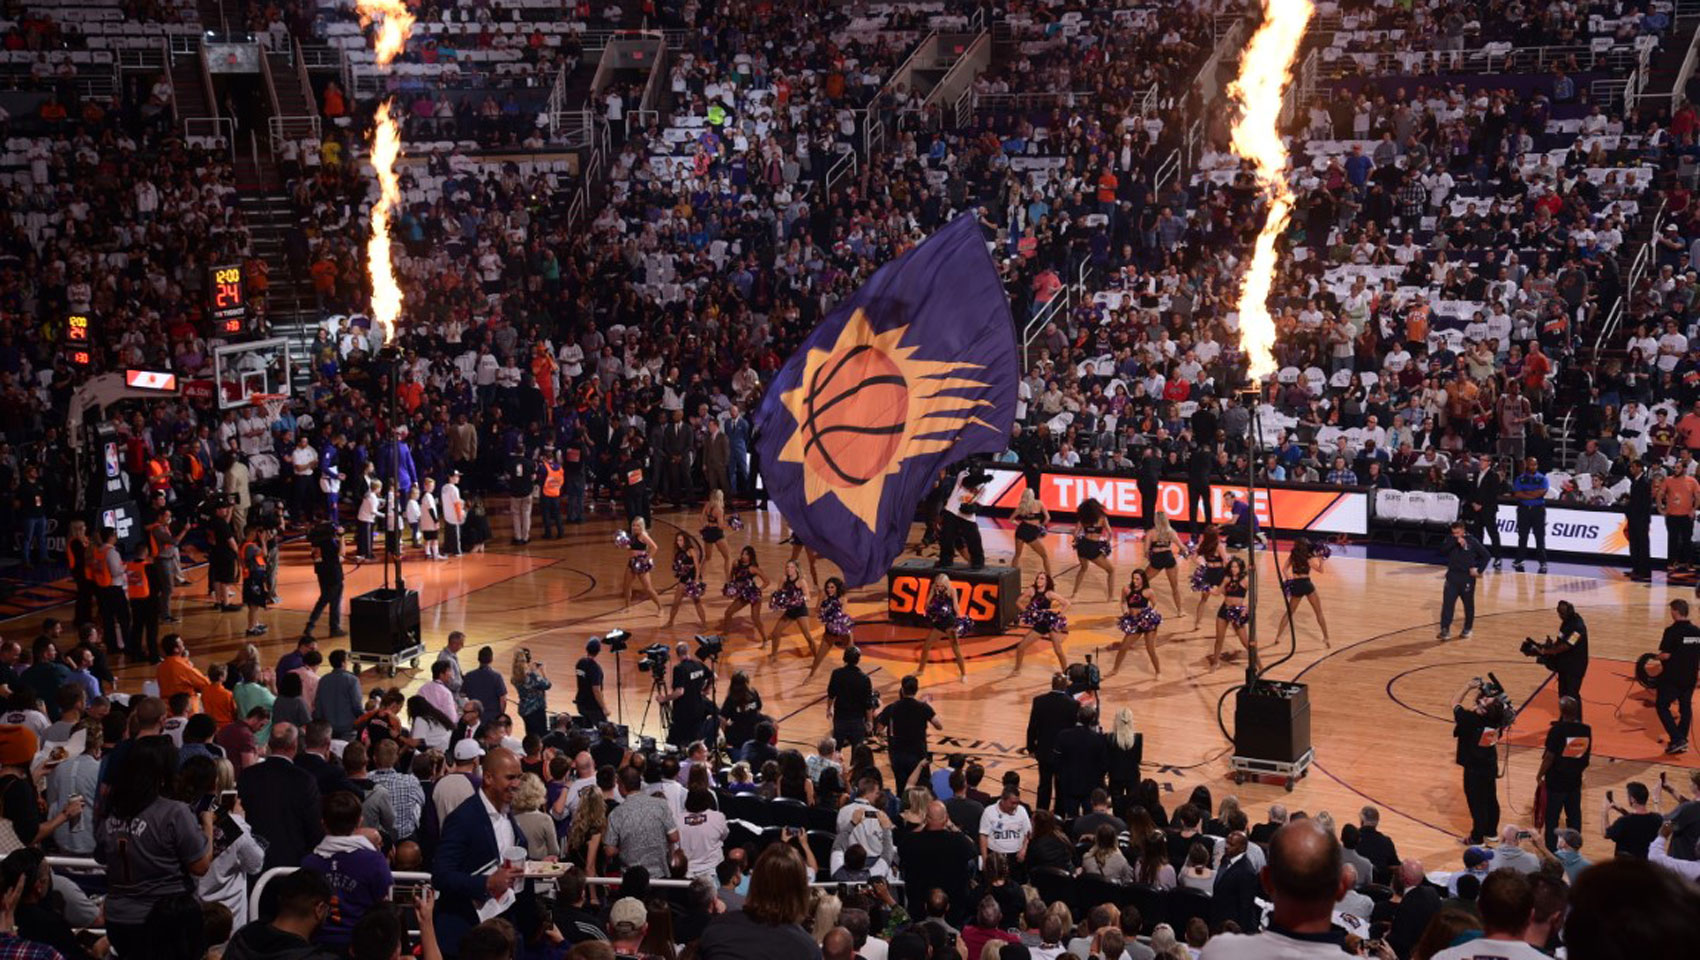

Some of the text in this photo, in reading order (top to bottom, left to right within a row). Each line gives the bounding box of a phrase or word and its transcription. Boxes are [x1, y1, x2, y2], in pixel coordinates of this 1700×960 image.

[215, 268, 240, 284] 12:00
[216, 283, 239, 307] 24
[70, 326, 86, 339] 24
[1053, 477, 1138, 513] TIME
[1156, 484, 1185, 516] O
